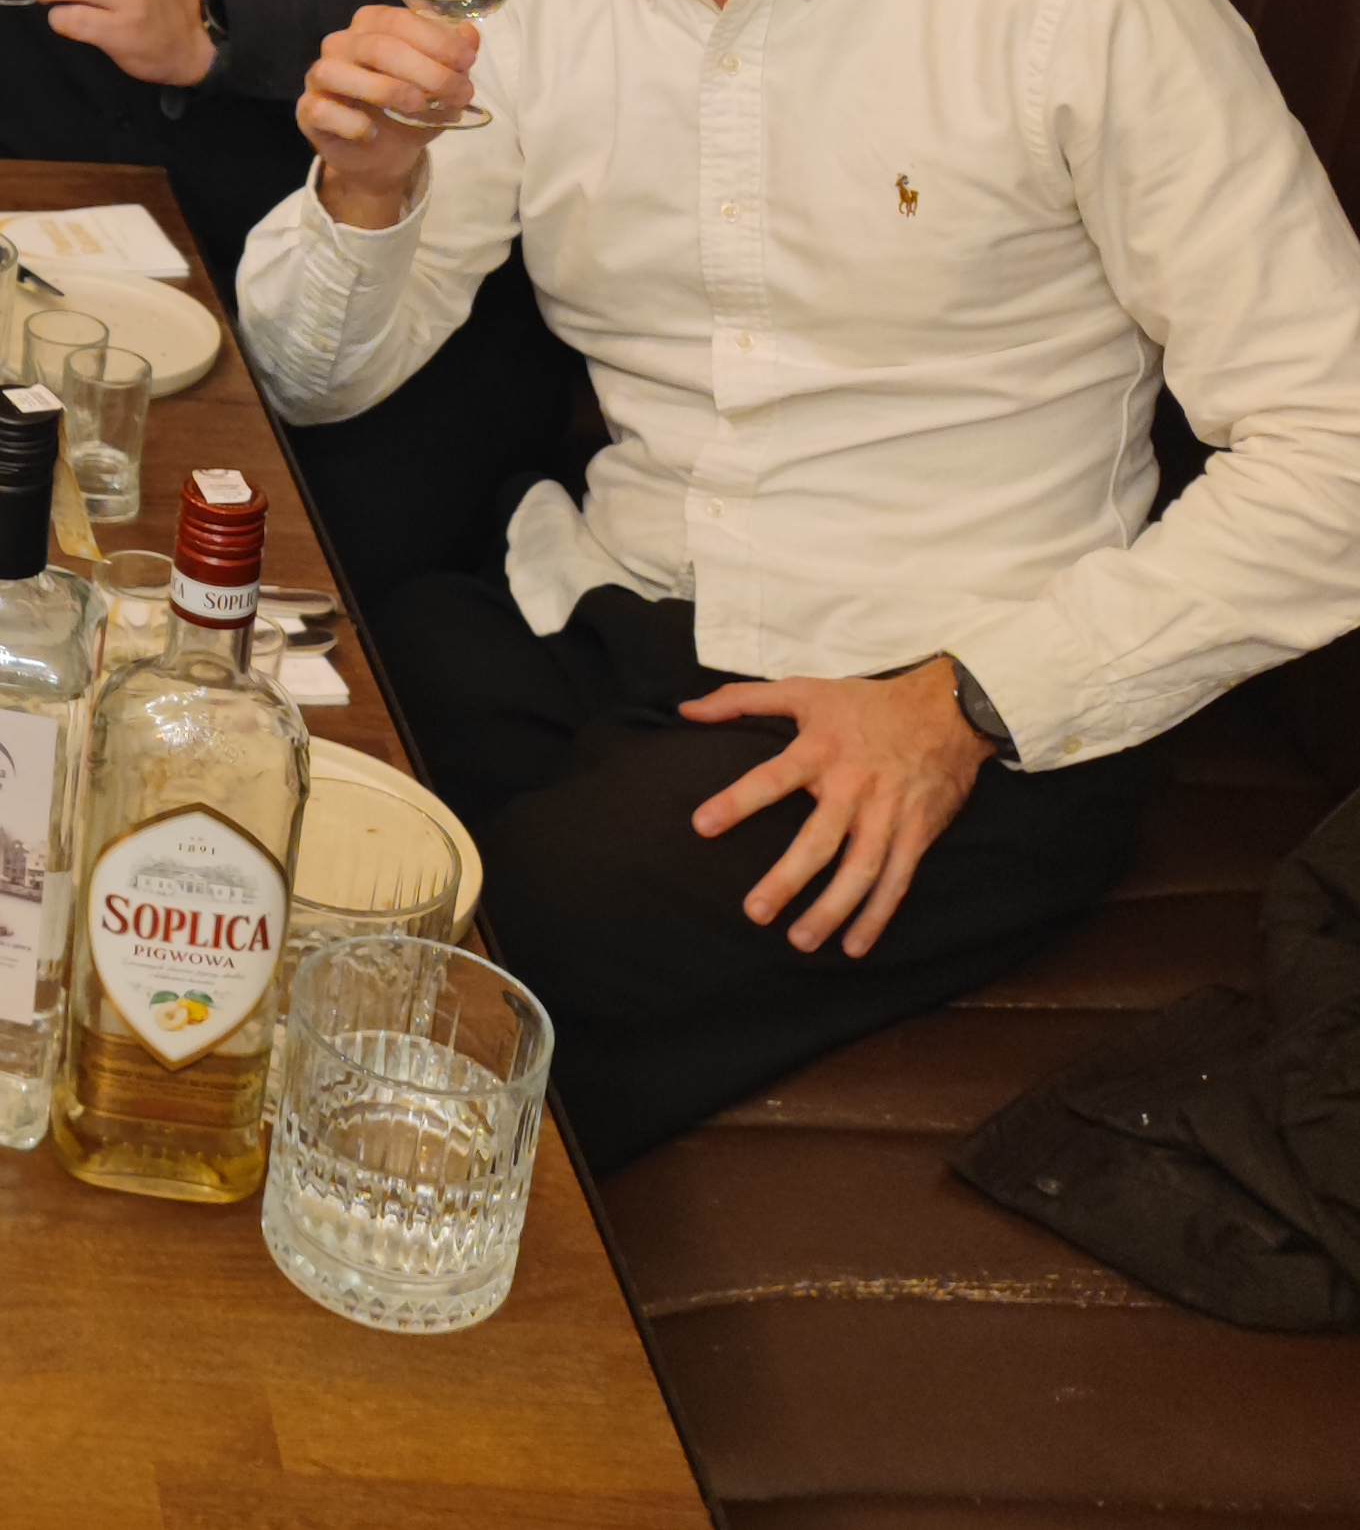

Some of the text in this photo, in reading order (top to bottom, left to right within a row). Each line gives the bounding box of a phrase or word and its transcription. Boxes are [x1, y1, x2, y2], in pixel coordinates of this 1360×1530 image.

[178, 842, 215, 855] 1891
[102, 893, 272, 953] SOPLICA
[134, 944, 235, 969] PIGWOWA
